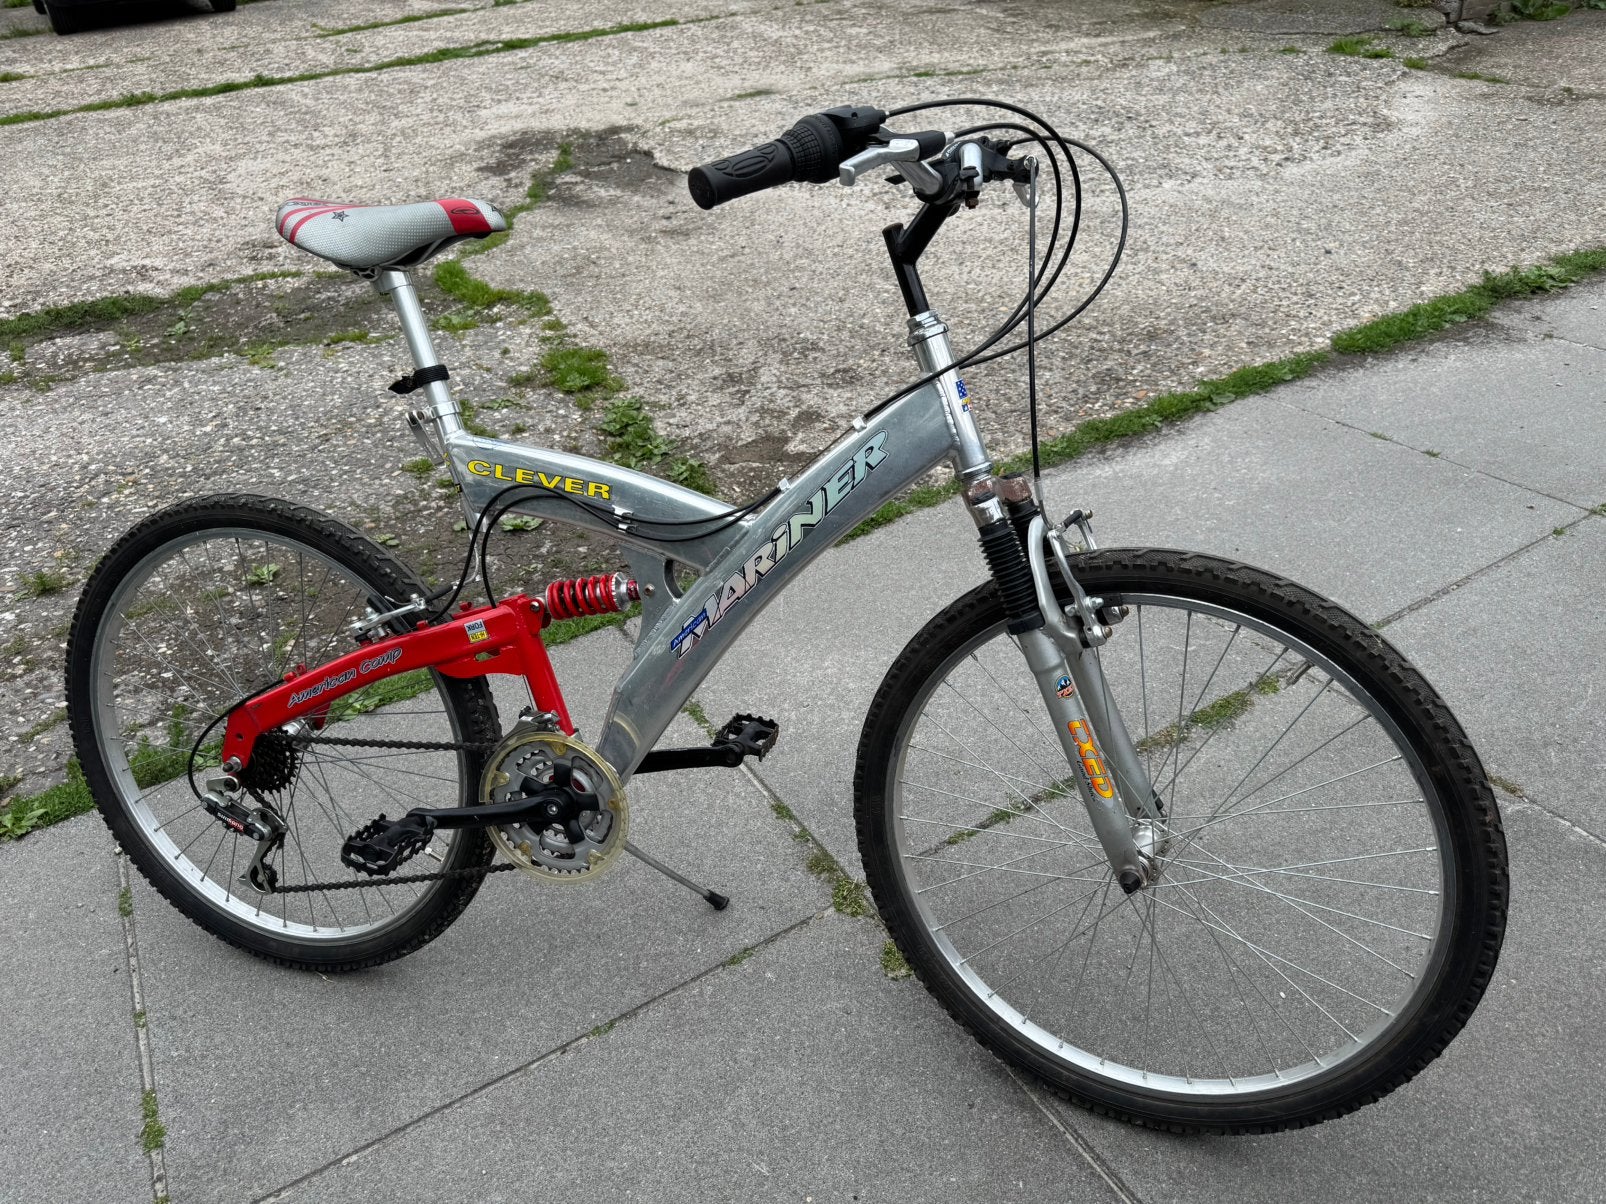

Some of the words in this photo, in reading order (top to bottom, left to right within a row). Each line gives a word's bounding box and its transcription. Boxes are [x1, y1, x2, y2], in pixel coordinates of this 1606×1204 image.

[467, 460, 611, 499] CLEVER
[287, 667, 357, 708] American
[359, 647, 403, 674] Comp
